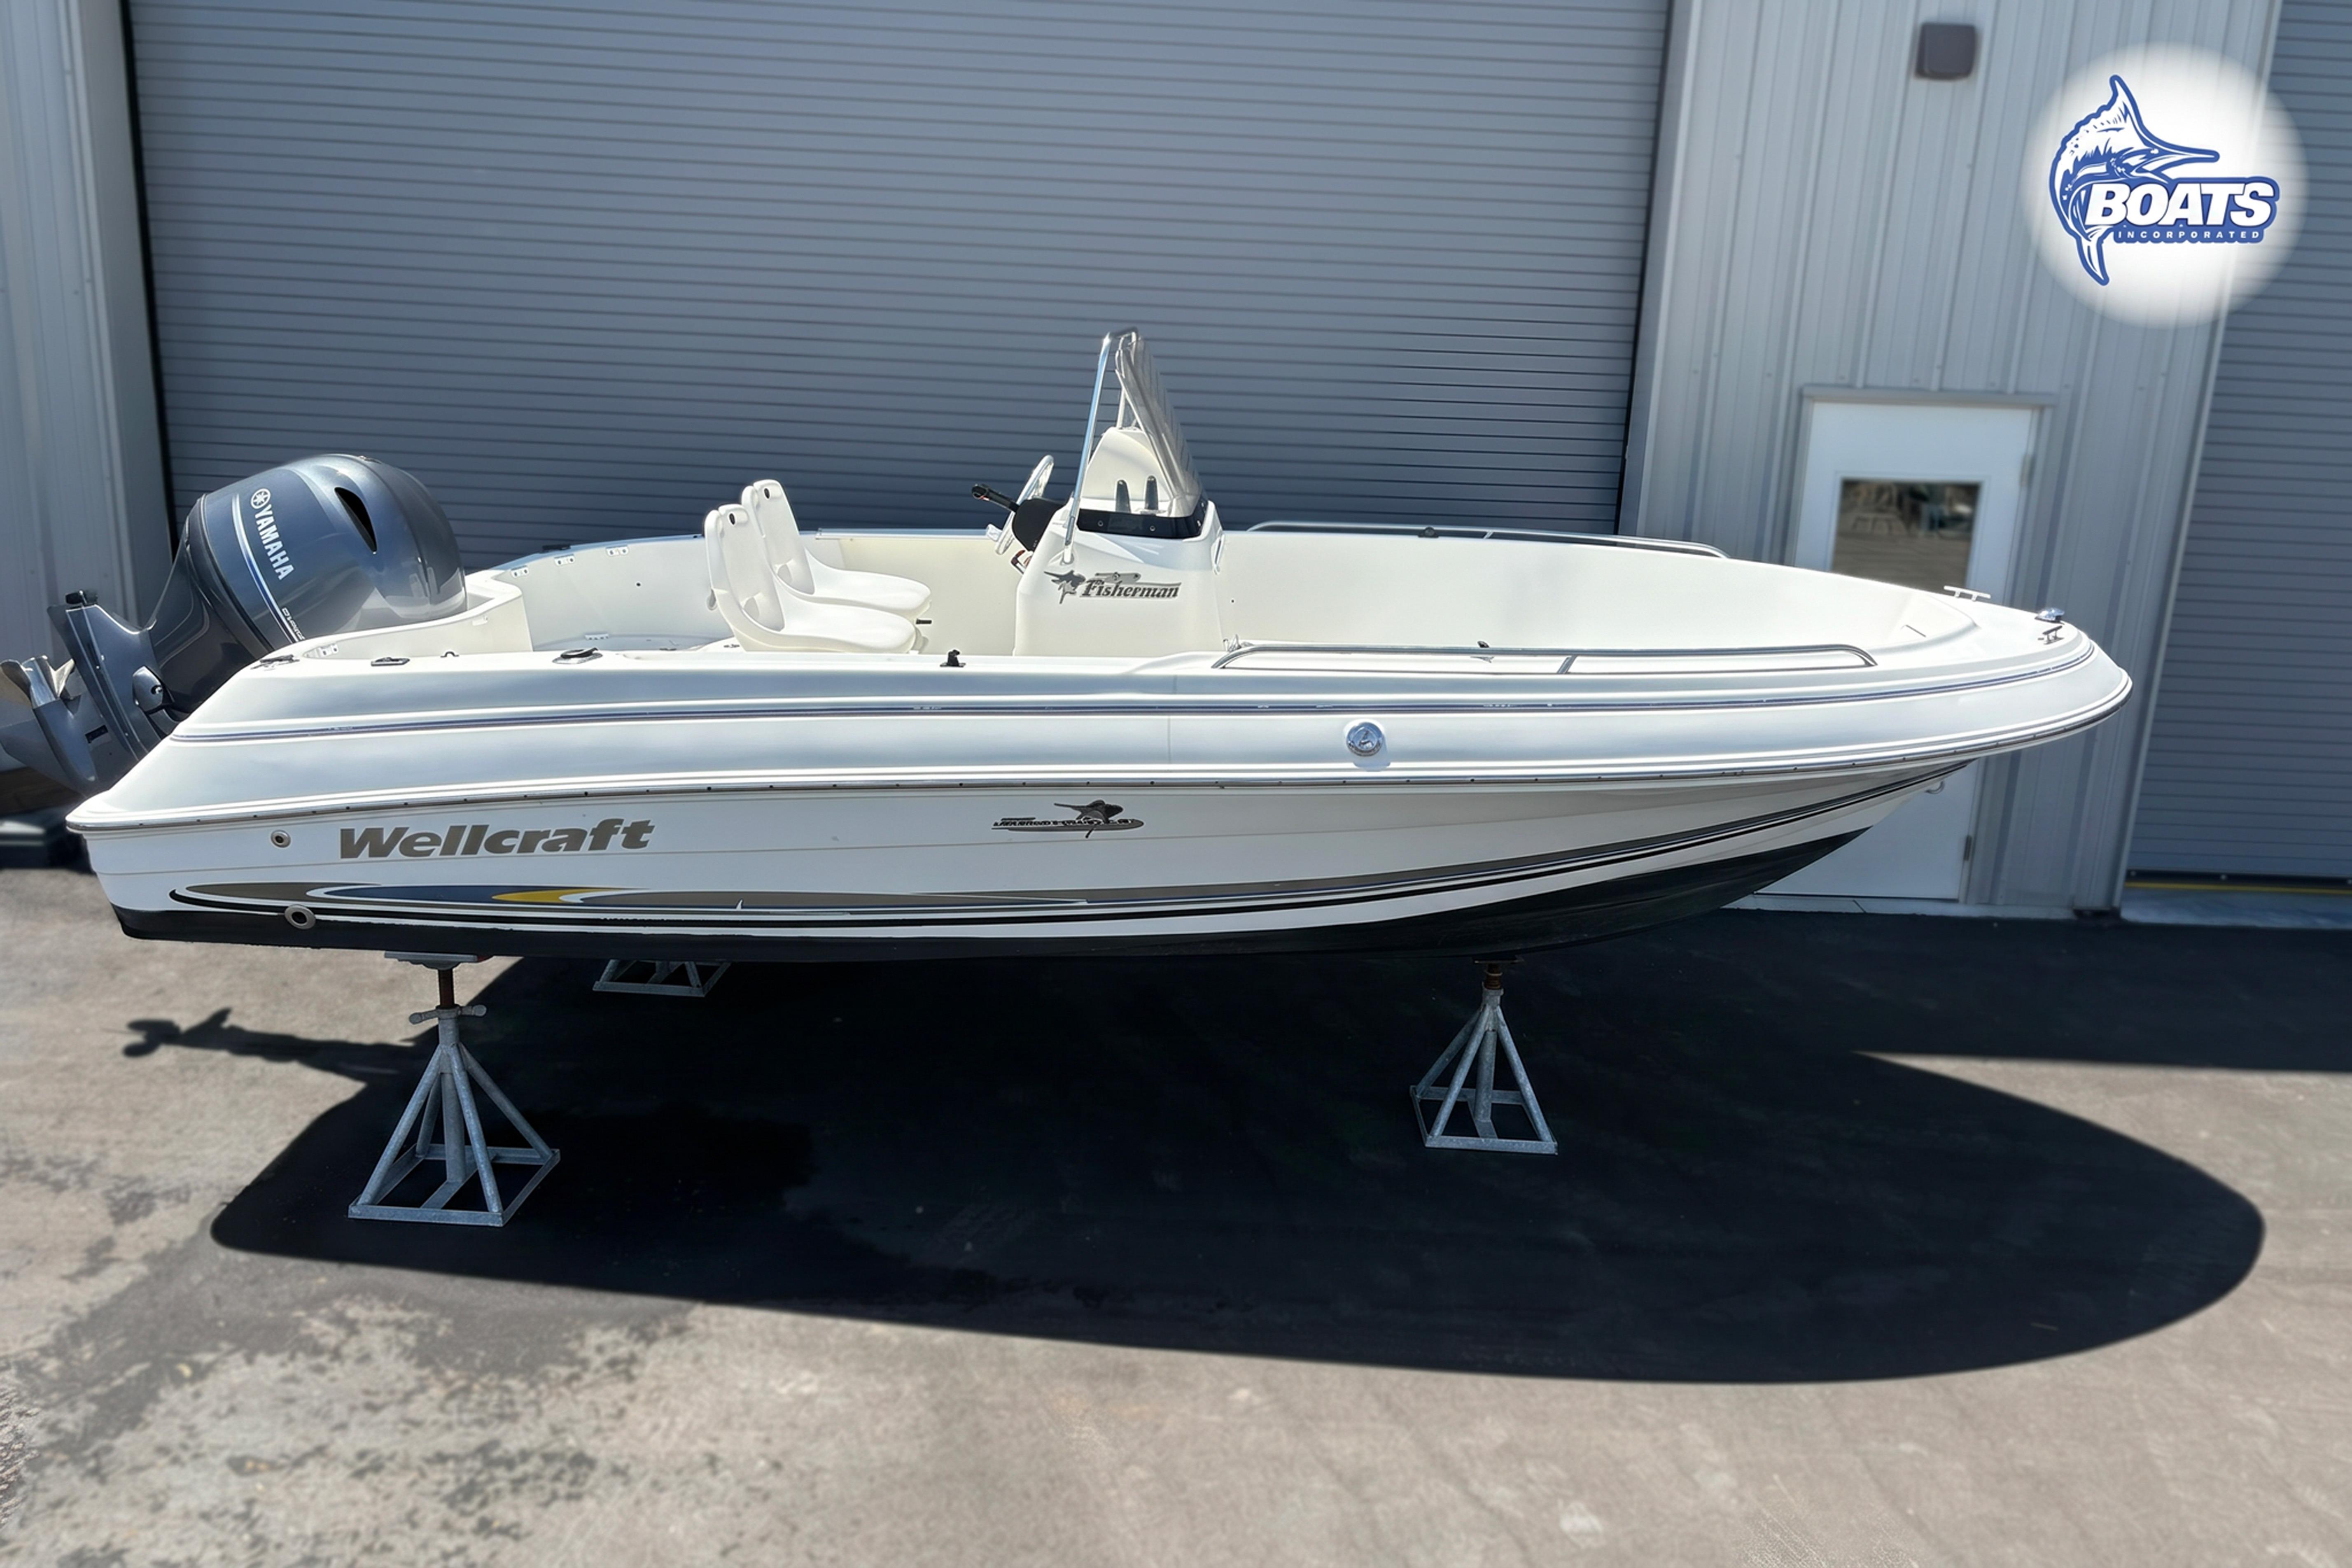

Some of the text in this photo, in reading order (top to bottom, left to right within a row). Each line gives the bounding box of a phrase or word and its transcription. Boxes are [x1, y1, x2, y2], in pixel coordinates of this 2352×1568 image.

[254, 504, 294, 581] YAMAHA
[1082, 579, 1180, 598] Fisherman
[340, 819, 656, 859] Wellcraft
